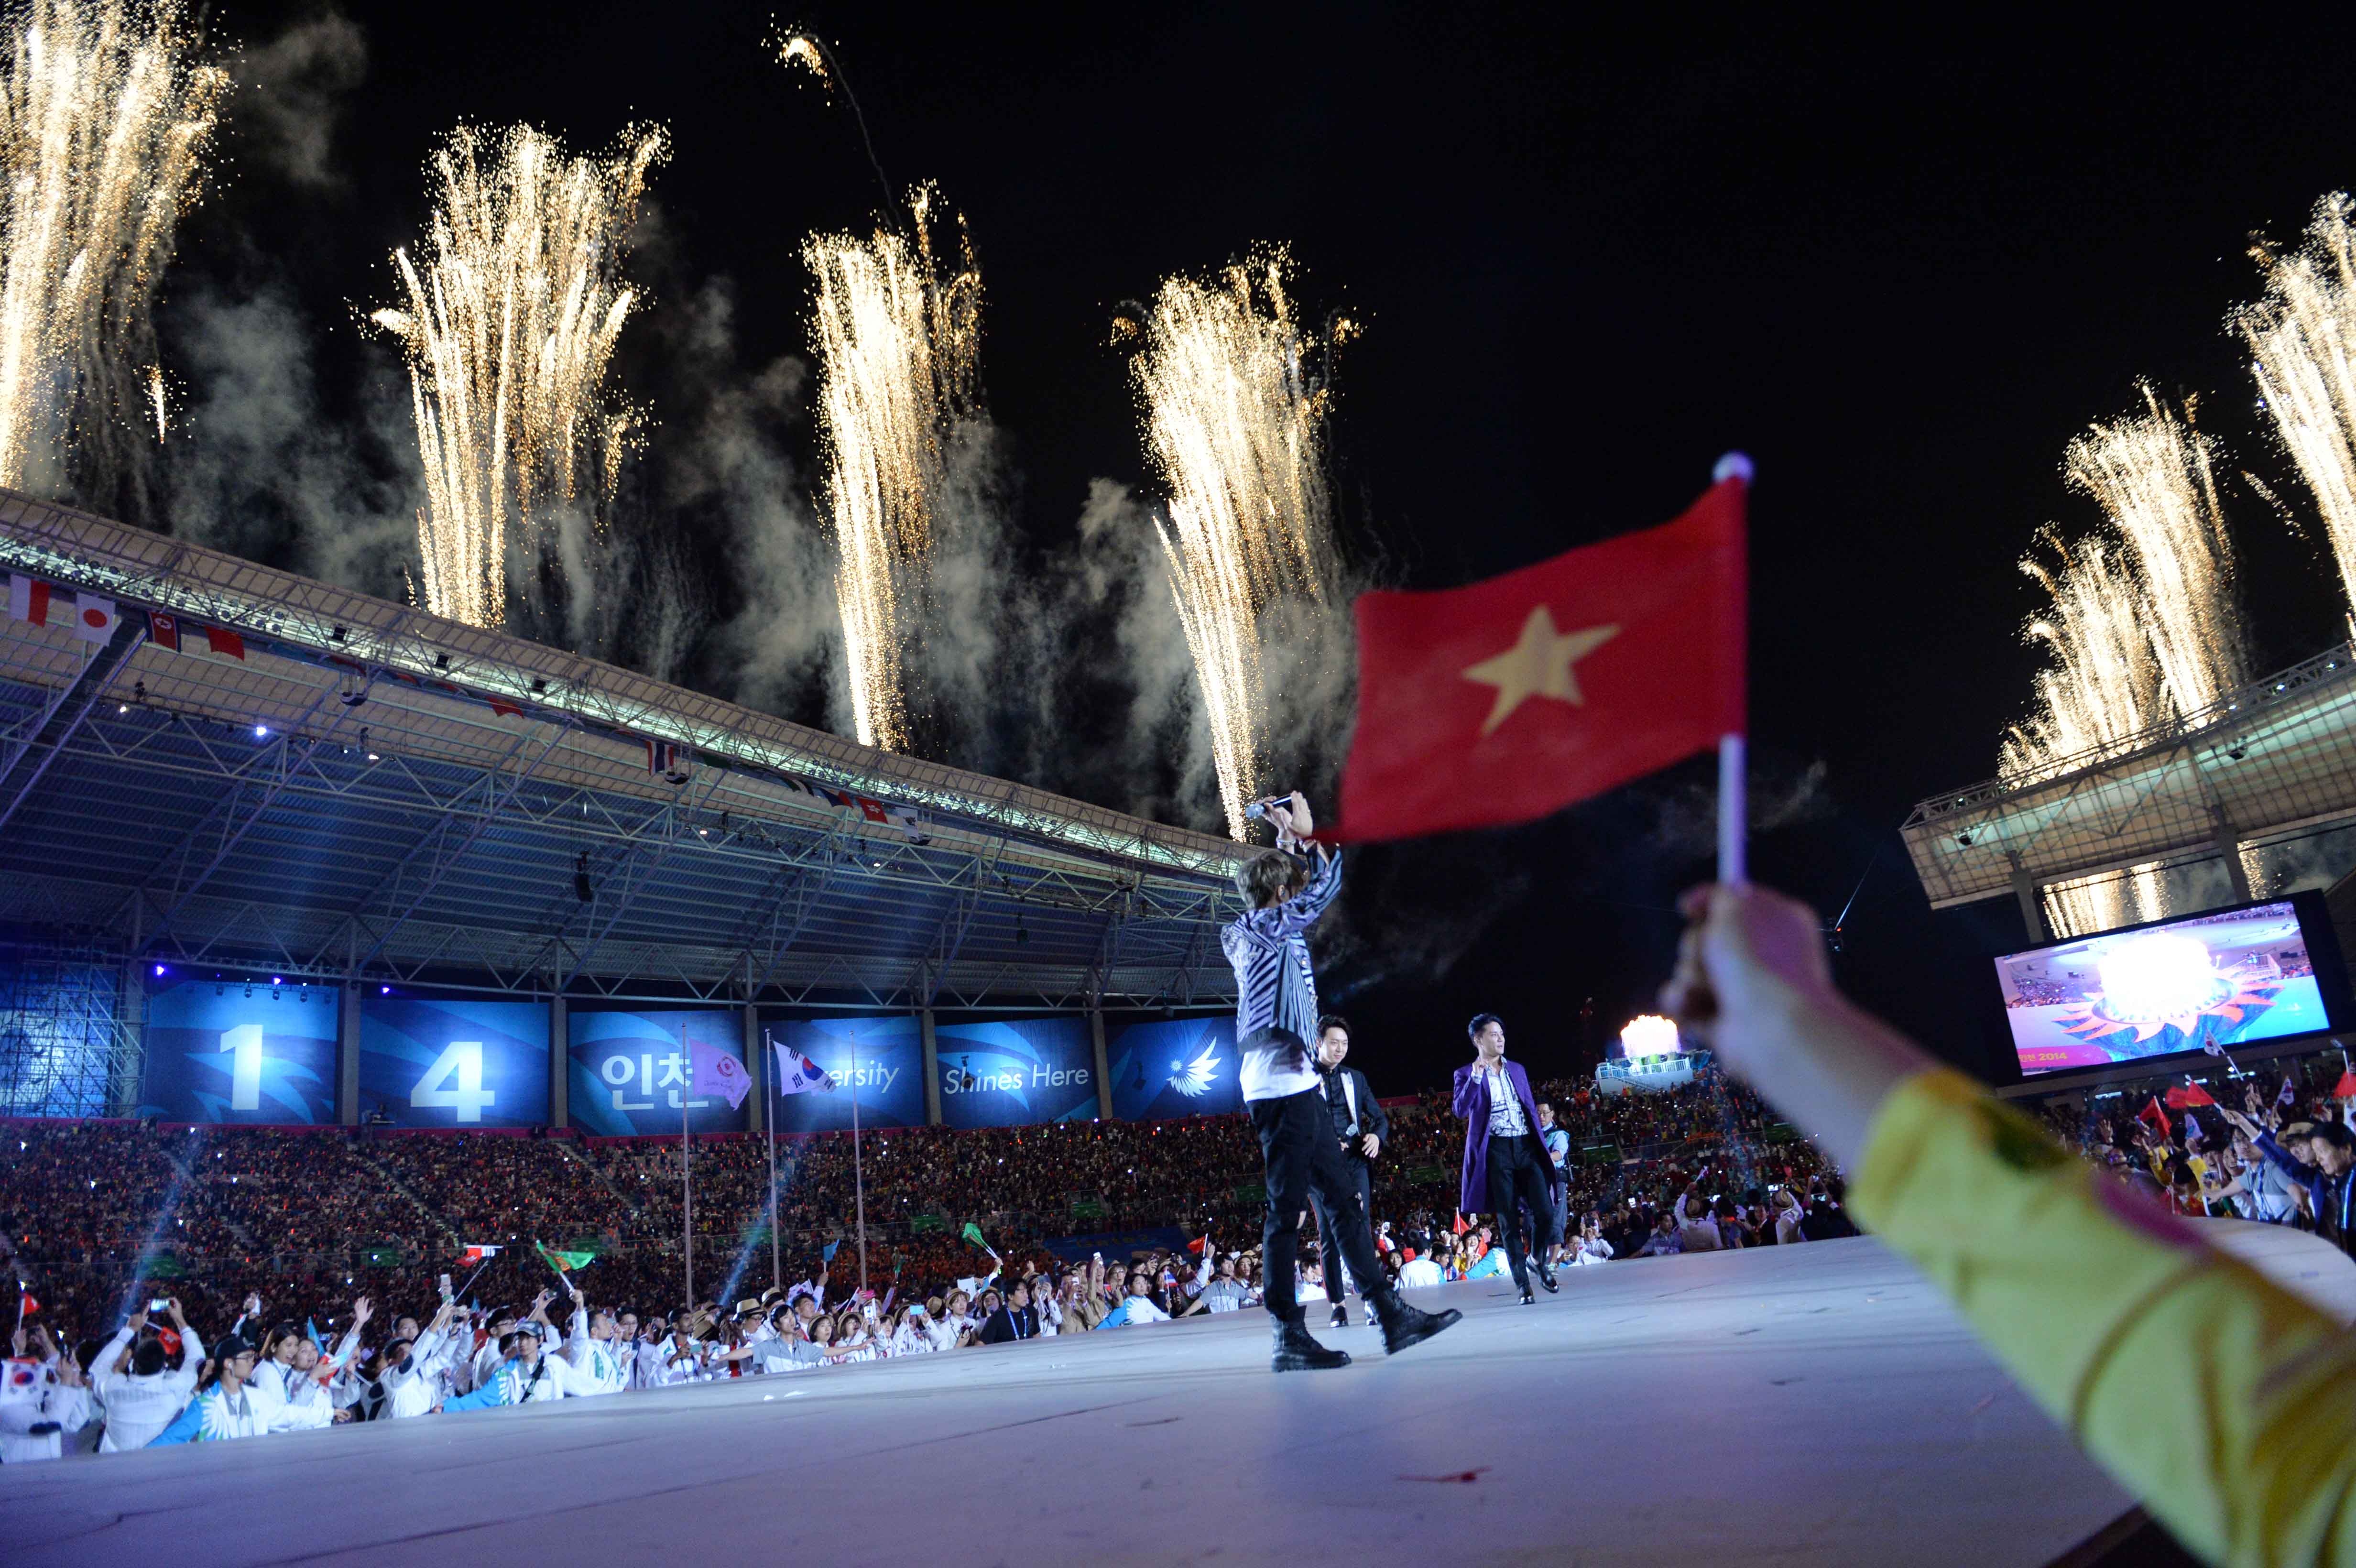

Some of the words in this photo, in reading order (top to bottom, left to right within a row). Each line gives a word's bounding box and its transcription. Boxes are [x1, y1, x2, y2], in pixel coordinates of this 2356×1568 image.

[220, 1024, 263, 1110] 1
[826, 1060, 899, 1093] ersity
[944, 1066, 1023, 1094] Shines
[1032, 1063, 1089, 1088] Here
[2038, 1053, 2068, 1061] 2014
[410, 1041, 495, 1122] 4
[601, 1053, 709, 1110] 인천
